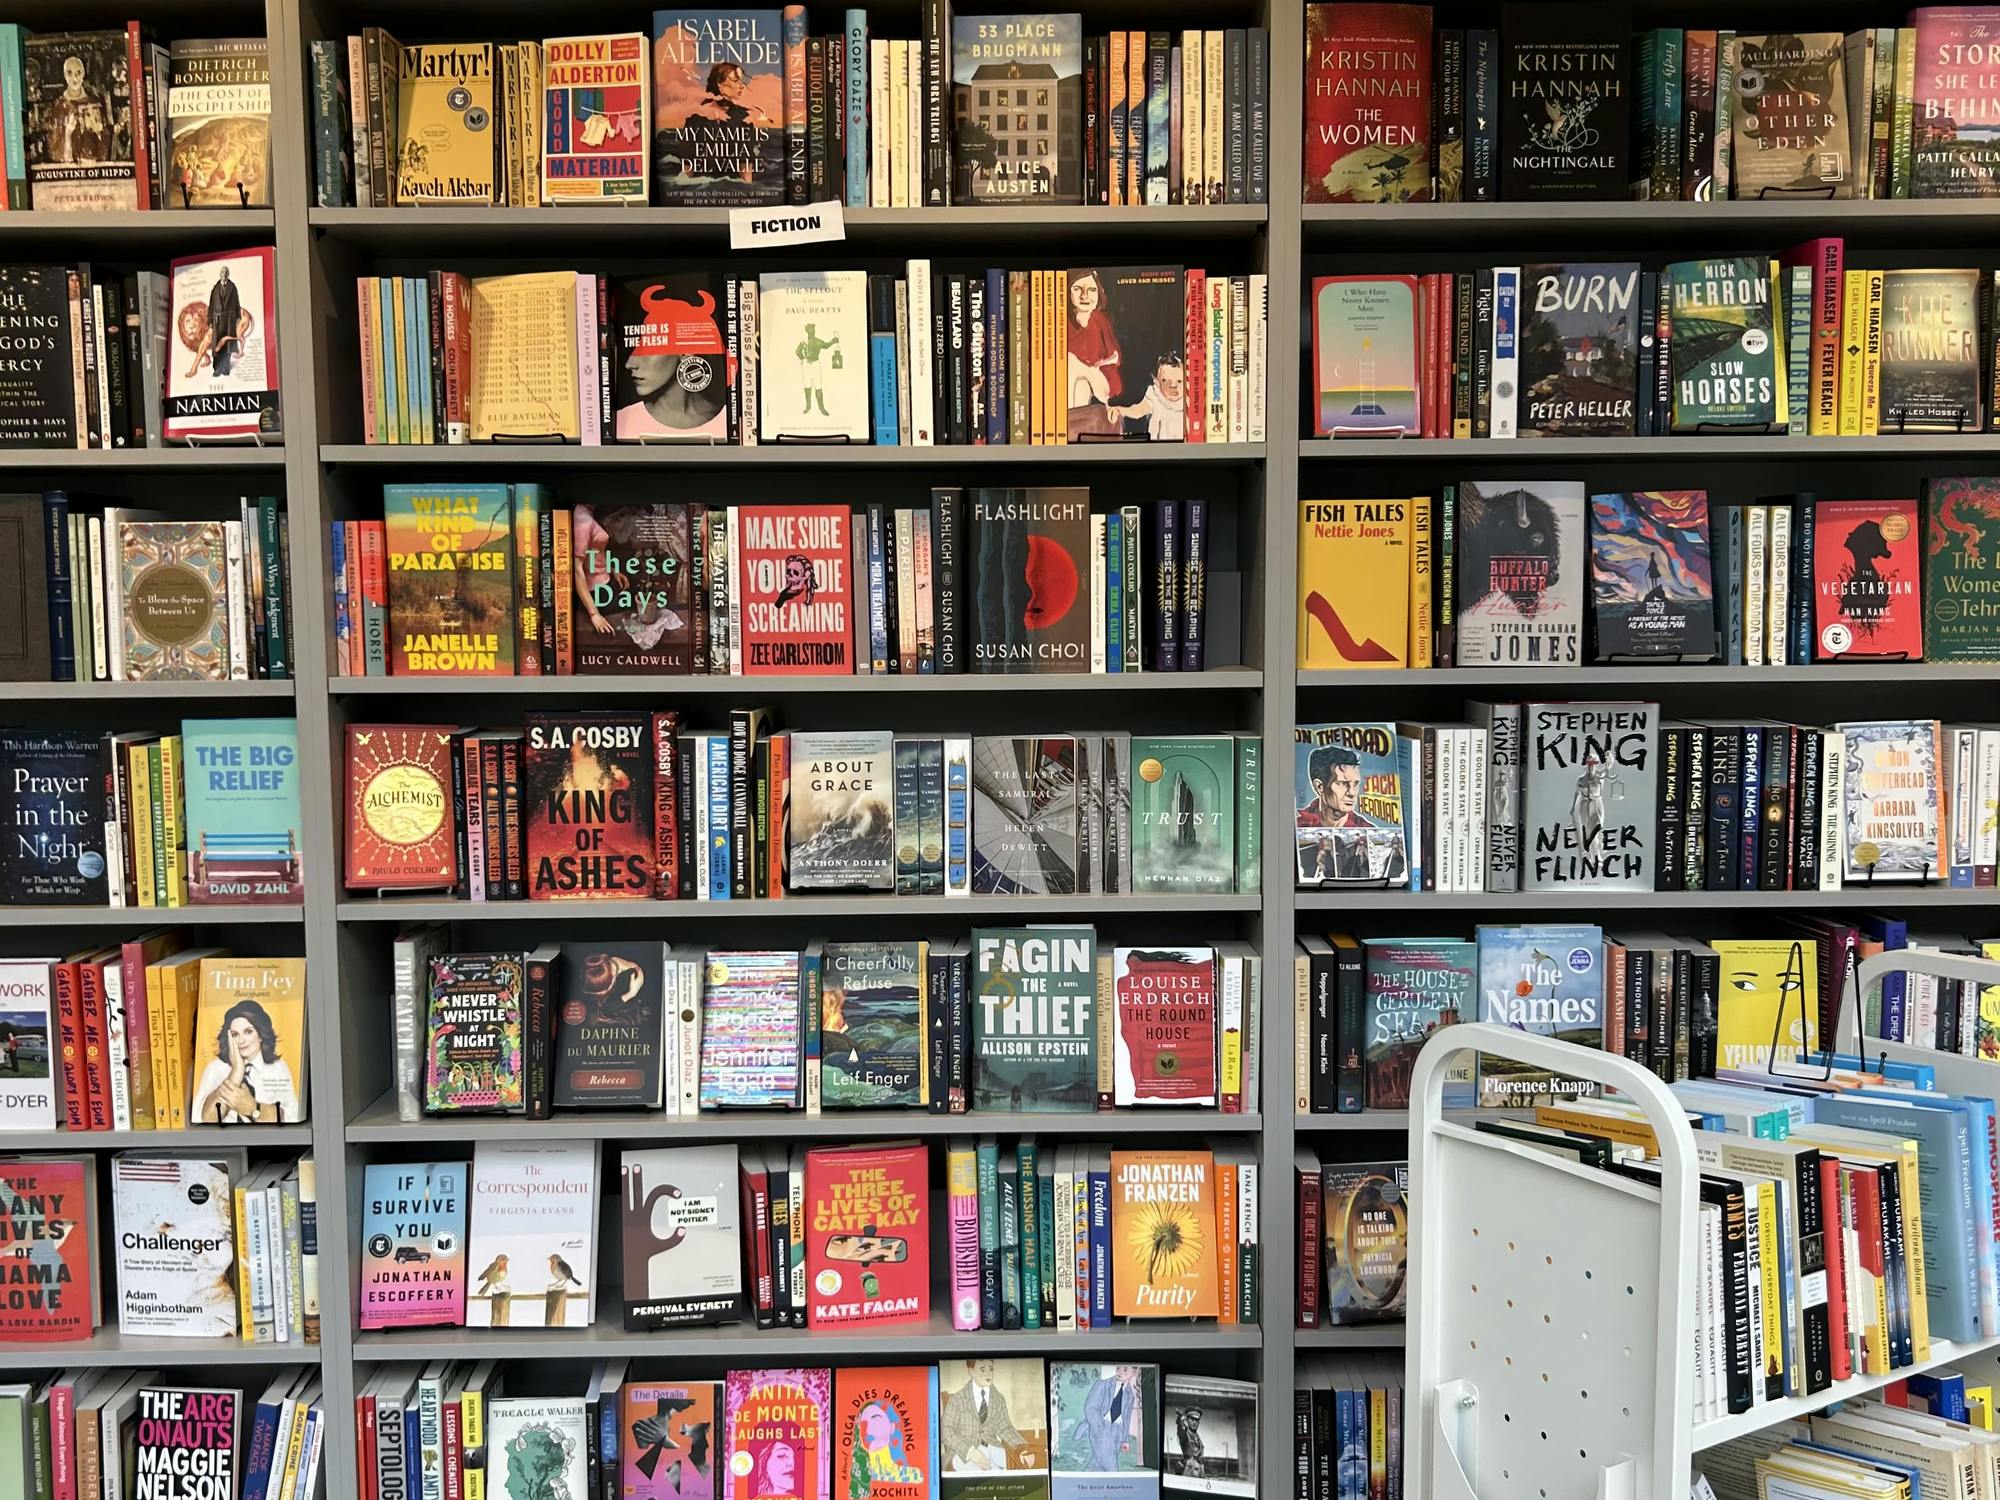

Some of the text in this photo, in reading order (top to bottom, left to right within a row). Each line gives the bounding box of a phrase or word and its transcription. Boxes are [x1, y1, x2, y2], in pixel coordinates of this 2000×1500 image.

[677, 19, 765, 41] ISABEL
[979, 24, 1055, 37] 33 PLACE
[550, 44, 605, 62] DOLLY
[661, 42, 779, 64] ALLENDE
[972, 44, 1062, 57] BRUGMANN
[402, 46, 490, 84] Martyr!
[852, 28, 861, 112] GLORY DAZE
[1321, 51, 1416, 70] KRISTIN
[550, 64, 637, 84] ALDERTON
[1316, 78, 1421, 98] HANNAH
[505, 46, 518, 157] MARTYR!
[1757, 94, 1822, 108] THIS
[1355, 109, 1382, 122] THE
[1746, 115, 1836, 129] OTHER
[1320, 125, 1416, 145] WOMEN
[1758, 136, 1827, 150] EDEN
[36, 170, 85, 178] AUGUSTINE
[102, 169, 130, 177] HIPPO
[550, 158, 639, 176] MATERIAL
[401, 176, 492, 198] Kaveh Akbar
[751, 216, 821, 234] FICTION
[1704, 264, 1734, 278] MICK
[1535, 271, 1639, 313] BURN
[1675, 278, 1768, 307] HERRON
[1823, 245, 1837, 324] CARL HIAASEN
[951, 281, 962, 349] BEAUTYLAND
[1478, 288, 1491, 323] Piglet
[624, 325, 658, 335] TENDER
[661, 324, 669, 334] IS
[742, 292, 752, 351] Big Swiss
[624, 336, 669, 347] THE FLESH
[1710, 361, 1744, 376] SLOW
[1821, 344, 1835, 416] FEVER BEACH
[1681, 377, 1770, 405] HORSES
[176, 395, 259, 414] NARNIAN
[1530, 400, 1632, 419] PETER HELLER
[412, 497, 479, 514] WHAT
[974, 504, 1085, 520] FLASHLIGHT
[1305, 505, 1404, 523] FISH TALES
[416, 515, 476, 533] KIND
[745, 517, 795, 550] MAKE
[799, 517, 842, 549] SURE
[1314, 523, 1394, 539] Nettie Jones
[431, 533, 461, 551] OF
[391, 552, 505, 570] PARADISE
[586, 549, 677, 574] These
[747, 559, 843, 594] YOU DIE
[1821, 581, 1912, 595] VEGETARIAN
[148, 596, 168, 604] Bless
[181, 595, 205, 605] Space
[594, 584, 668, 614] Days
[149, 606, 196, 615] Between Us
[748, 602, 844, 633] SCREAMING
[404, 634, 499, 652] JANELLE
[976, 643, 1085, 658] SUSAN CHOI
[408, 653, 495, 670] BROWN
[750, 643, 844, 666] ZEE CARLSTROM
[1537, 711, 1647, 733] STEPHEN
[530, 726, 643, 749] S. A. COSBY
[195, 746, 294, 766] THE BIG
[1536, 733, 1647, 771] KING
[811, 761, 874, 773] ABOUT
[13, 768, 89, 798] Prayer
[209, 771, 284, 790] RELIEF
[711, 743, 728, 831] AMERICAN DIRT
[811, 779, 873, 791] GRACE
[366, 792, 443, 809] ALCHEMIST
[549, 790, 631, 825] KING
[15, 800, 88, 826] in the
[1142, 812, 1224, 825] TRUST
[575, 829, 605, 851] OF
[1535, 822, 1643, 852] NEVER
[19, 833, 86, 864] Night
[535, 855, 648, 890] ASHES
[1535, 853, 1642, 882] FLINCH
[979, 939, 1090, 973] FAGIN
[211, 970, 295, 995] Tina Fey
[1521, 963, 1562, 986] The
[1021, 978, 1047, 992] THE
[452, 995, 497, 1008] NEVER
[1485, 989, 1596, 1023] Names
[443, 1009, 506, 1023] WHISTLE
[979, 996, 1091, 1035] THIEF
[469, 1024, 479, 1032] AT
[581, 1028, 639, 1040] DAPHNE
[453, 1034, 496, 1048] NIGHT
[567, 1044, 651, 1057] DU MAURIER
[589, 1073, 626, 1086] Rebecca
[1484, 1078, 1594, 1096] Florence Knapp
[523, 1165, 544, 1176] The
[849, 1168, 887, 1183] THE
[1117, 1164, 1205, 1184] JONATHAN
[398, 1176, 431, 1190] IF I
[477, 1180, 589, 1198] Correspondent
[830, 1180, 904, 1199] THREE
[1124, 1183, 1200, 1202] FRANZEN
[372, 1199, 456, 1215] SURVIVE
[817, 1194, 913, 1216] LIVES OF
[813, 1208, 921, 1232] CATE KAY
[1362, 1211, 1387, 1221] NO ONE
[395, 1223, 432, 1238] YOU
[1357, 1224, 1394, 1234] IS TALKING
[1894, 1197, 1905, 1256] MURAKAMI
[122, 1233, 223, 1255] Challenger
[1747, 1206, 1761, 1271] JUSTICE
[955, 1218, 979, 1291] BOMBSHELL
[126, 1290, 157, 1301] Adam
[1136, 1284, 1196, 1310] Purity
[126, 1303, 203, 1315] Higginbotham
[633, 1300, 734, 1316] PERCIVAL EVERETT
[815, 1297, 919, 1318] KATE FAGAN
[749, 1384, 806, 1401] ANITA
[139, 1390, 234, 1422] THE ARG
[493, 1405, 584, 1418] TREACLE WALKER
[734, 1405, 820, 1422] DE MONTE
[139, 1419, 233, 1448] ONAUTS
[730, 1427, 823, 1440] LAUGHS LAST
[138, 1447, 231, 1475] MAGGIE
